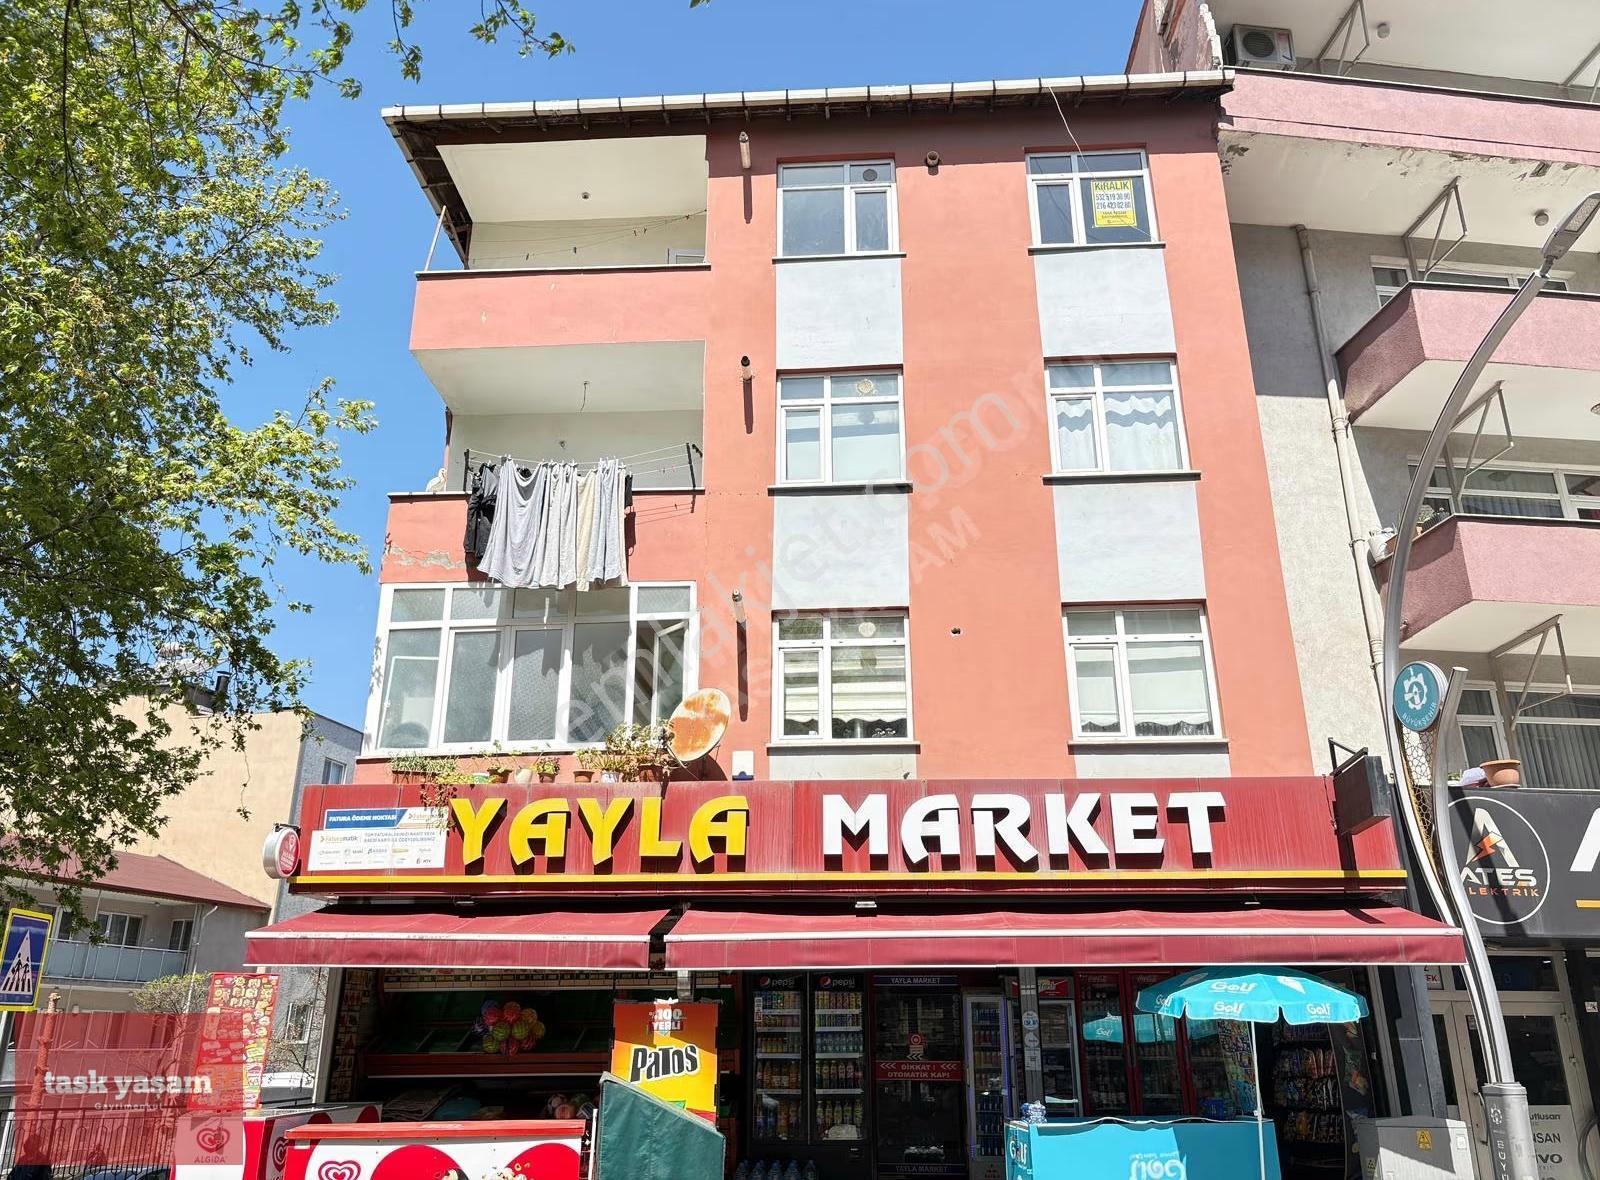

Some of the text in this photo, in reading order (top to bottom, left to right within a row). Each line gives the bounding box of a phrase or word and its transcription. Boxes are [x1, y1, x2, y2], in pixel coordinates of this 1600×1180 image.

[450, 792, 1226, 866] YAYLA MARKET
[1469, 887, 1540, 897] LEKTRIK
[772, 979, 795, 987] pepsi
[832, 978, 855, 987] pepsi
[1210, 981, 1257, 993] Golf
[649, 1008, 682, 1020] %100
[1213, 1001, 1245, 1015] Golf
[1306, 1003, 1332, 1016] Golf
[901, 1063, 931, 1071] DİKKAT
